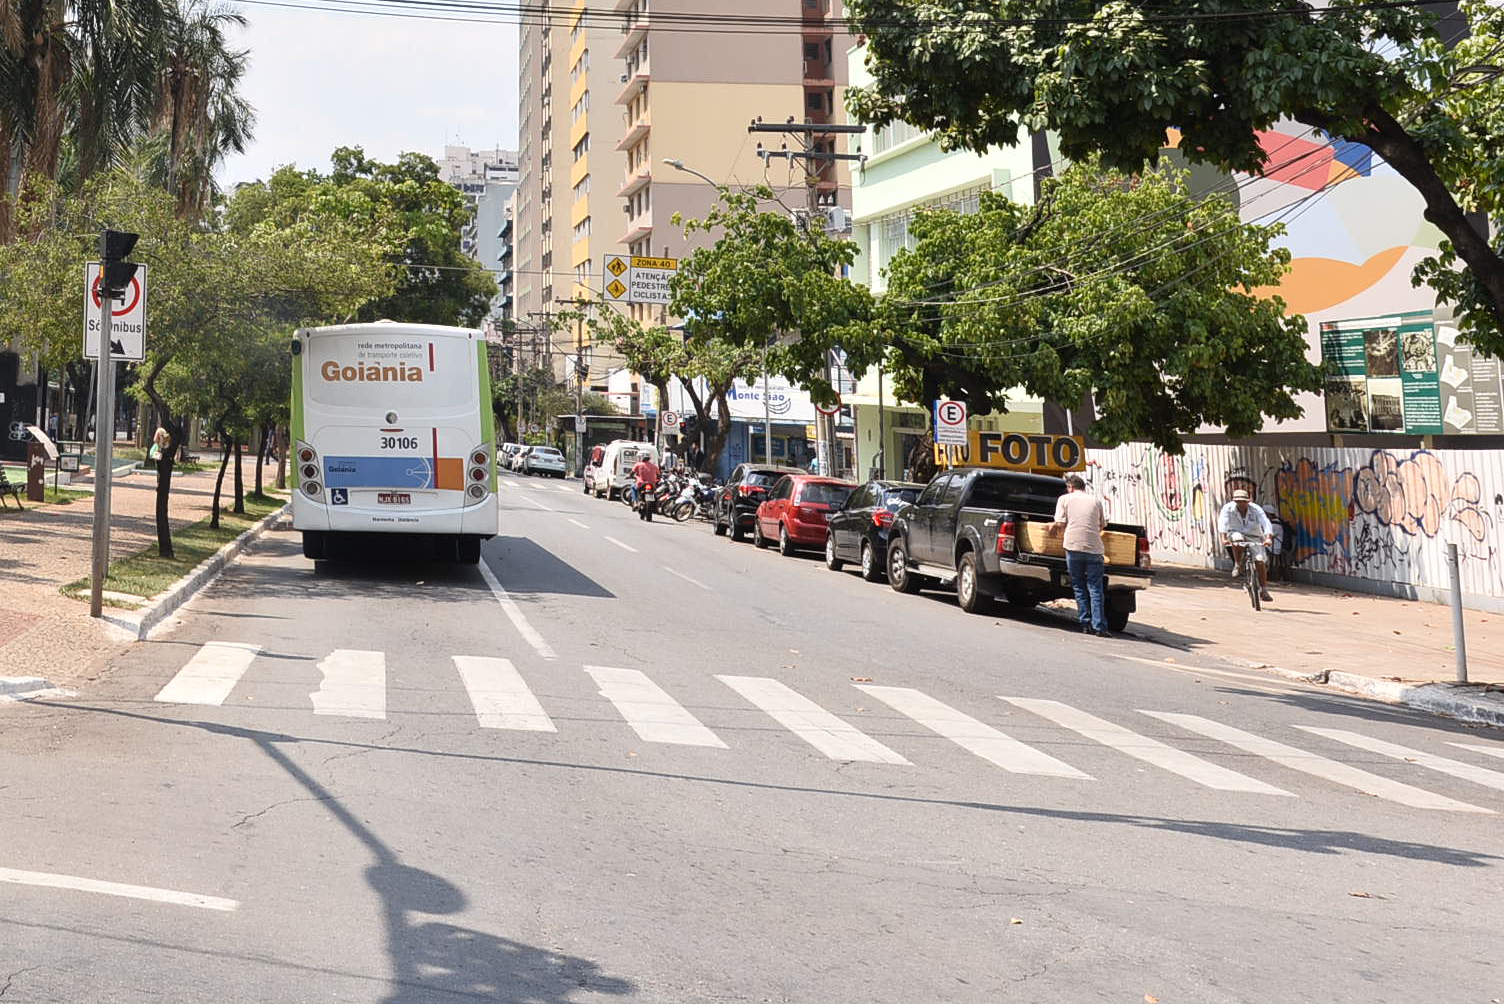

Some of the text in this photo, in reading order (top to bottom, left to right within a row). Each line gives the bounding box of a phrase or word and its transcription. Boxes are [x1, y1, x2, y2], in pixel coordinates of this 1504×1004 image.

[631, 281, 671, 290] PEDESTRE
[109, 320, 142, 333] nibus
[374, 341, 422, 350] metropolitana
[321, 360, 423, 382] Goiânia
[667, 414, 673, 423] E
[947, 406, 956, 420] E
[380, 437, 418, 449] 30106
[980, 432, 1079, 468] FOTO
